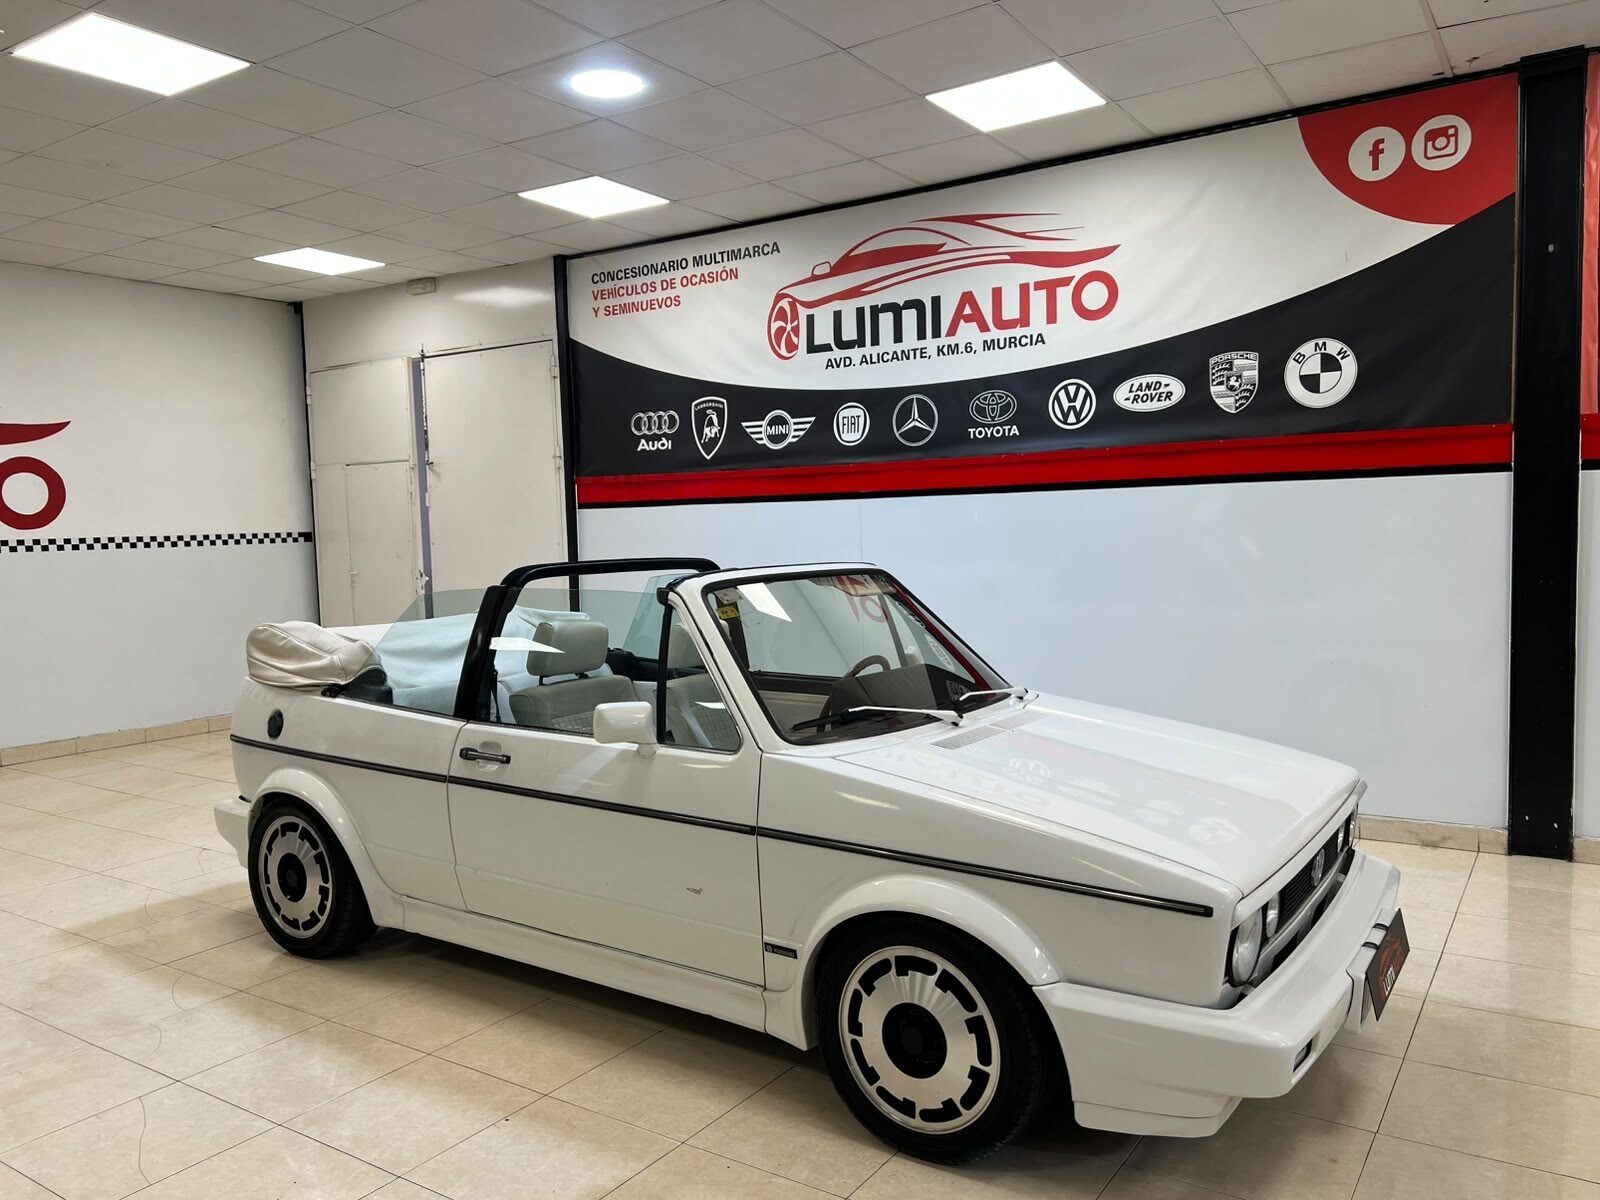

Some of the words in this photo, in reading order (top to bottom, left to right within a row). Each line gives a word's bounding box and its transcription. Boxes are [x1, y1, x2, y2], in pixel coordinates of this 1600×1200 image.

[592, 258, 688, 284] CONCESIONARIO
[692, 241, 780, 268] MULTIMARCA
[592, 280, 656, 300] VEHÍCULOS
[661, 276, 677, 292] DE
[680, 267, 738, 288] OCASIÓN
[592, 306, 601, 318] Y
[604, 294, 681, 317] SEMINUEVOS
[825, 355, 856, 370] AVD.
[859, 346, 932, 366] ALICANTE,
[936, 340, 977, 358] KM.6,
[982, 332, 1046, 351] MURCIA
[1211, 353, 1257, 365] PORSCHE
[766, 425, 789, 436] MINI
[841, 414, 861, 436] FIAT
[968, 424, 1020, 440] TOYOTA
[637, 438, 672, 452] Audi
